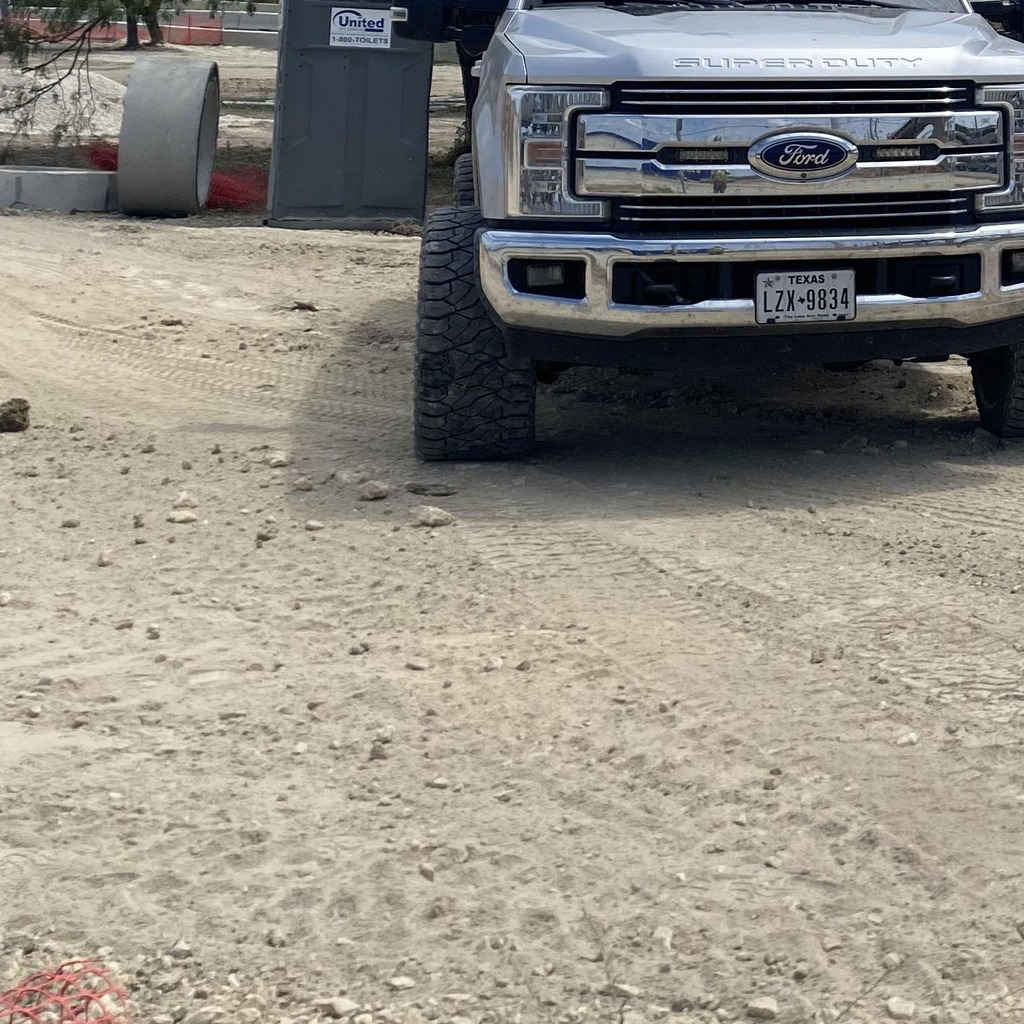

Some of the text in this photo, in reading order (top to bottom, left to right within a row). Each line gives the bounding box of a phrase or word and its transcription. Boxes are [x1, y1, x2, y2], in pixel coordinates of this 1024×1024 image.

[338, 16, 385, 28] United
[332, 36, 389, 44] 1-800-TOILETS
[672, 57, 923, 69] SUPER DUTY
[778, 144, 830, 166] Ford
[788, 274, 826, 285] TEXAS
